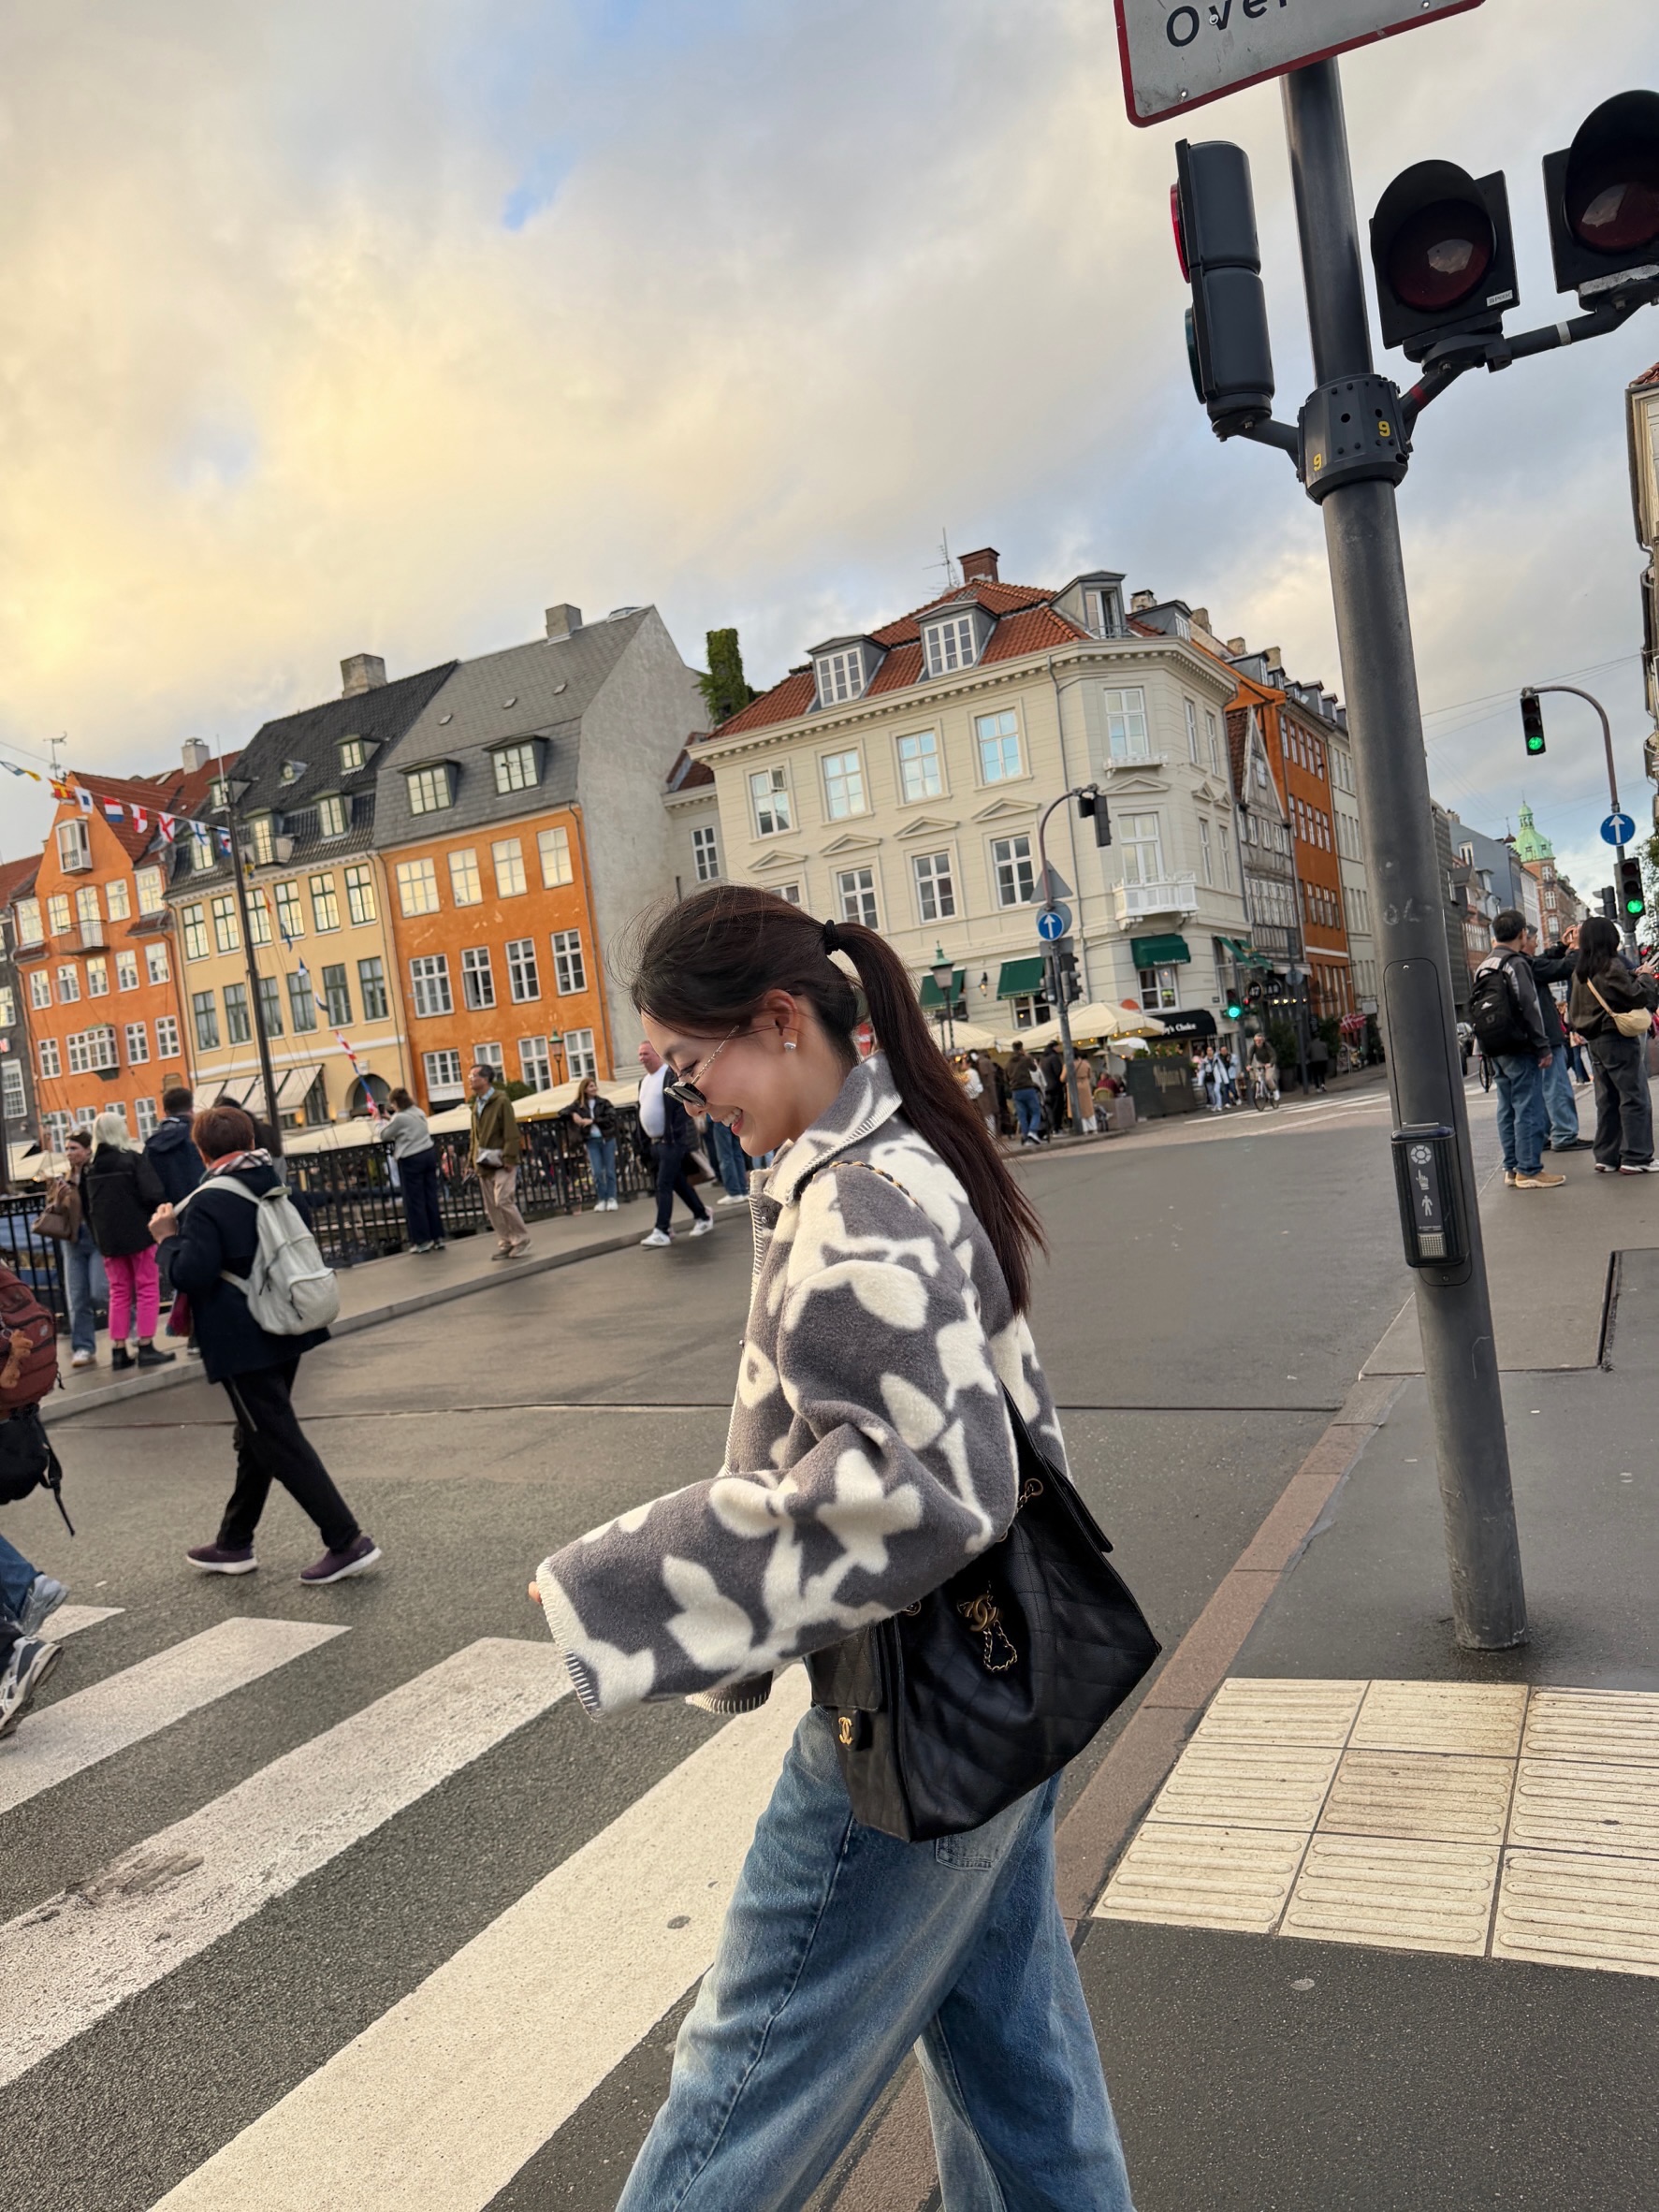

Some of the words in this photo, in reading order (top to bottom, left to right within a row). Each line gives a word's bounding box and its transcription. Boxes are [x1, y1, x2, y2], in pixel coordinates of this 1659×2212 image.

[1166, 0, 1288, 48] Ove
[1378, 420, 1391, 437] 9
[1313, 453, 1322, 472] 9
